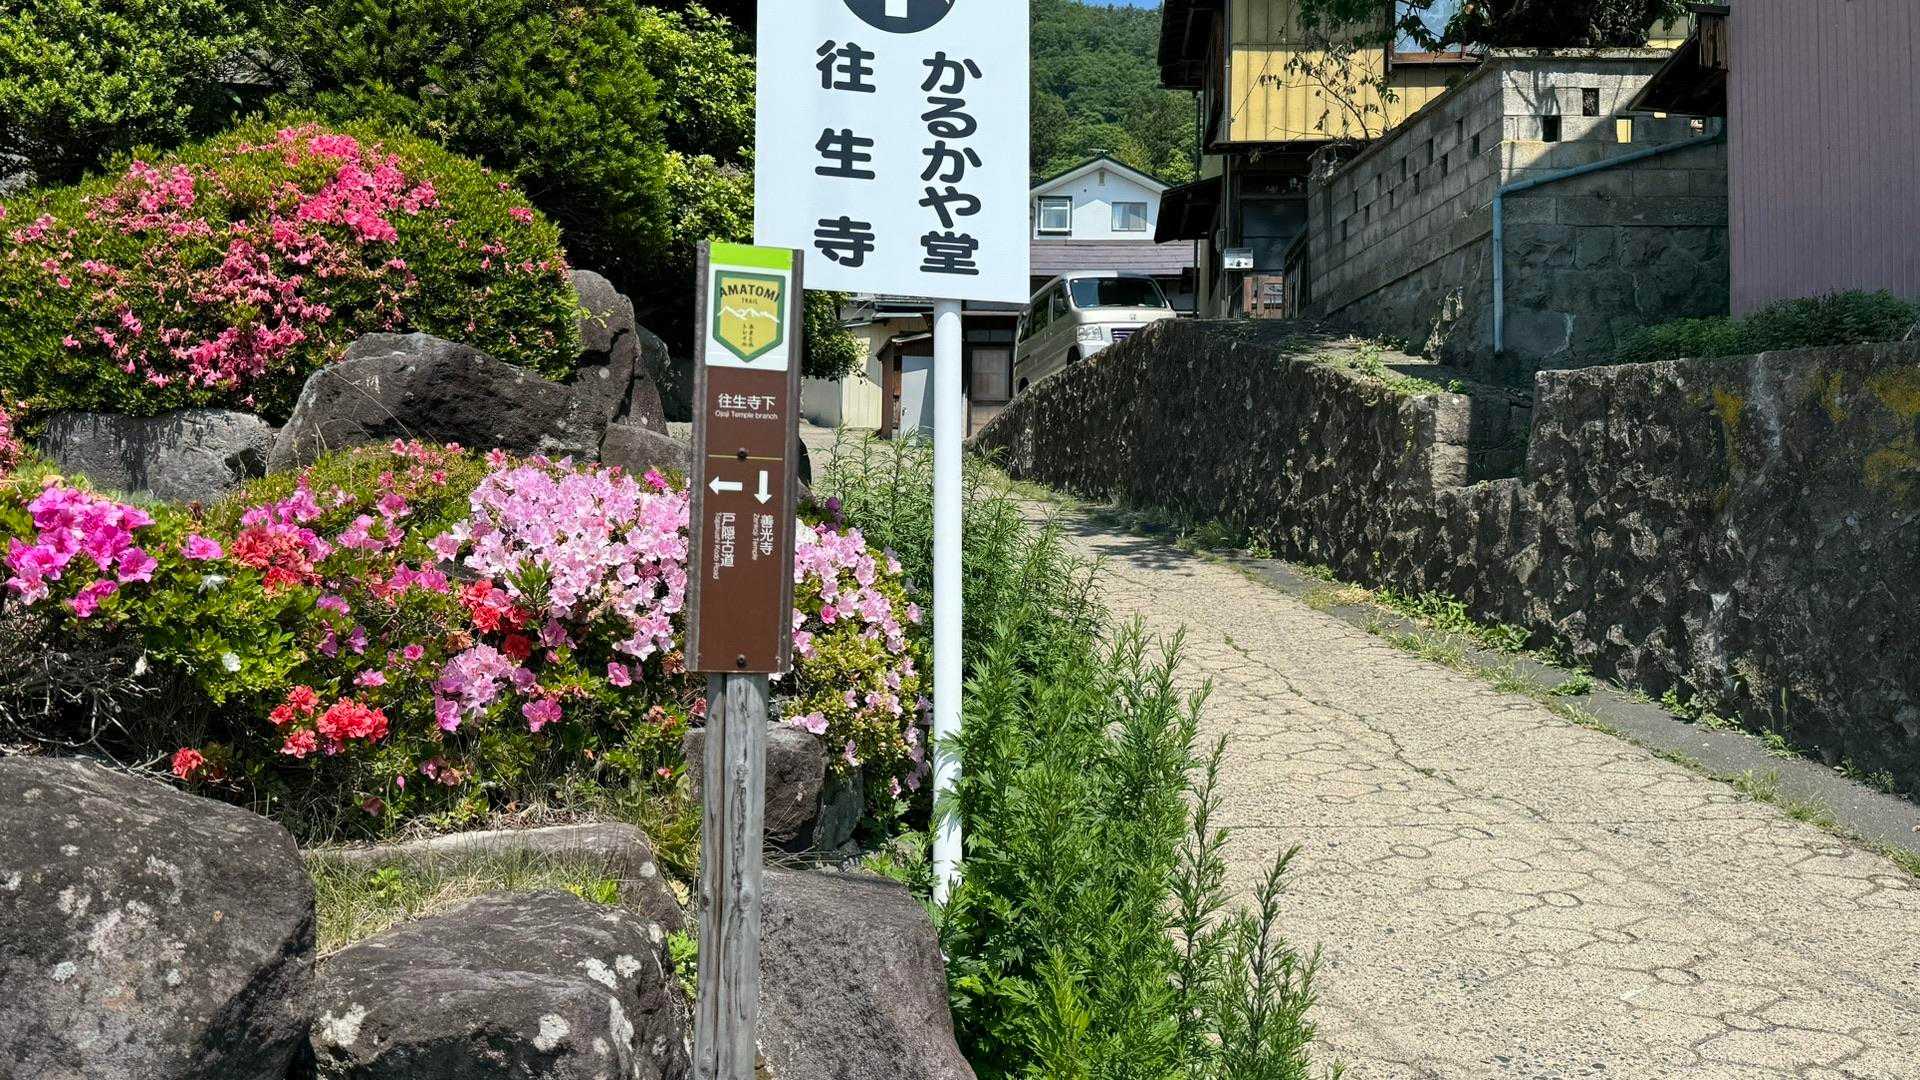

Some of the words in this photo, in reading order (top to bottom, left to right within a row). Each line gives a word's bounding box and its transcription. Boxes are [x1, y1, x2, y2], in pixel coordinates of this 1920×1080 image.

[814, 39, 876, 268] 往生寺
[918, 51, 983, 276] かるかや堂
[720, 284, 780, 303] AMATOMI
[741, 297, 758, 305] TRAIL
[718, 393, 776, 411] 往生寺下
[731, 411, 754, 420] Temple
[755, 412, 778, 420] branch
[720, 512, 736, 568] 戸隠古道
[759, 514, 774, 556] 善光寺
[751, 537, 759, 561] Temple
[712, 562, 720, 580] Road
